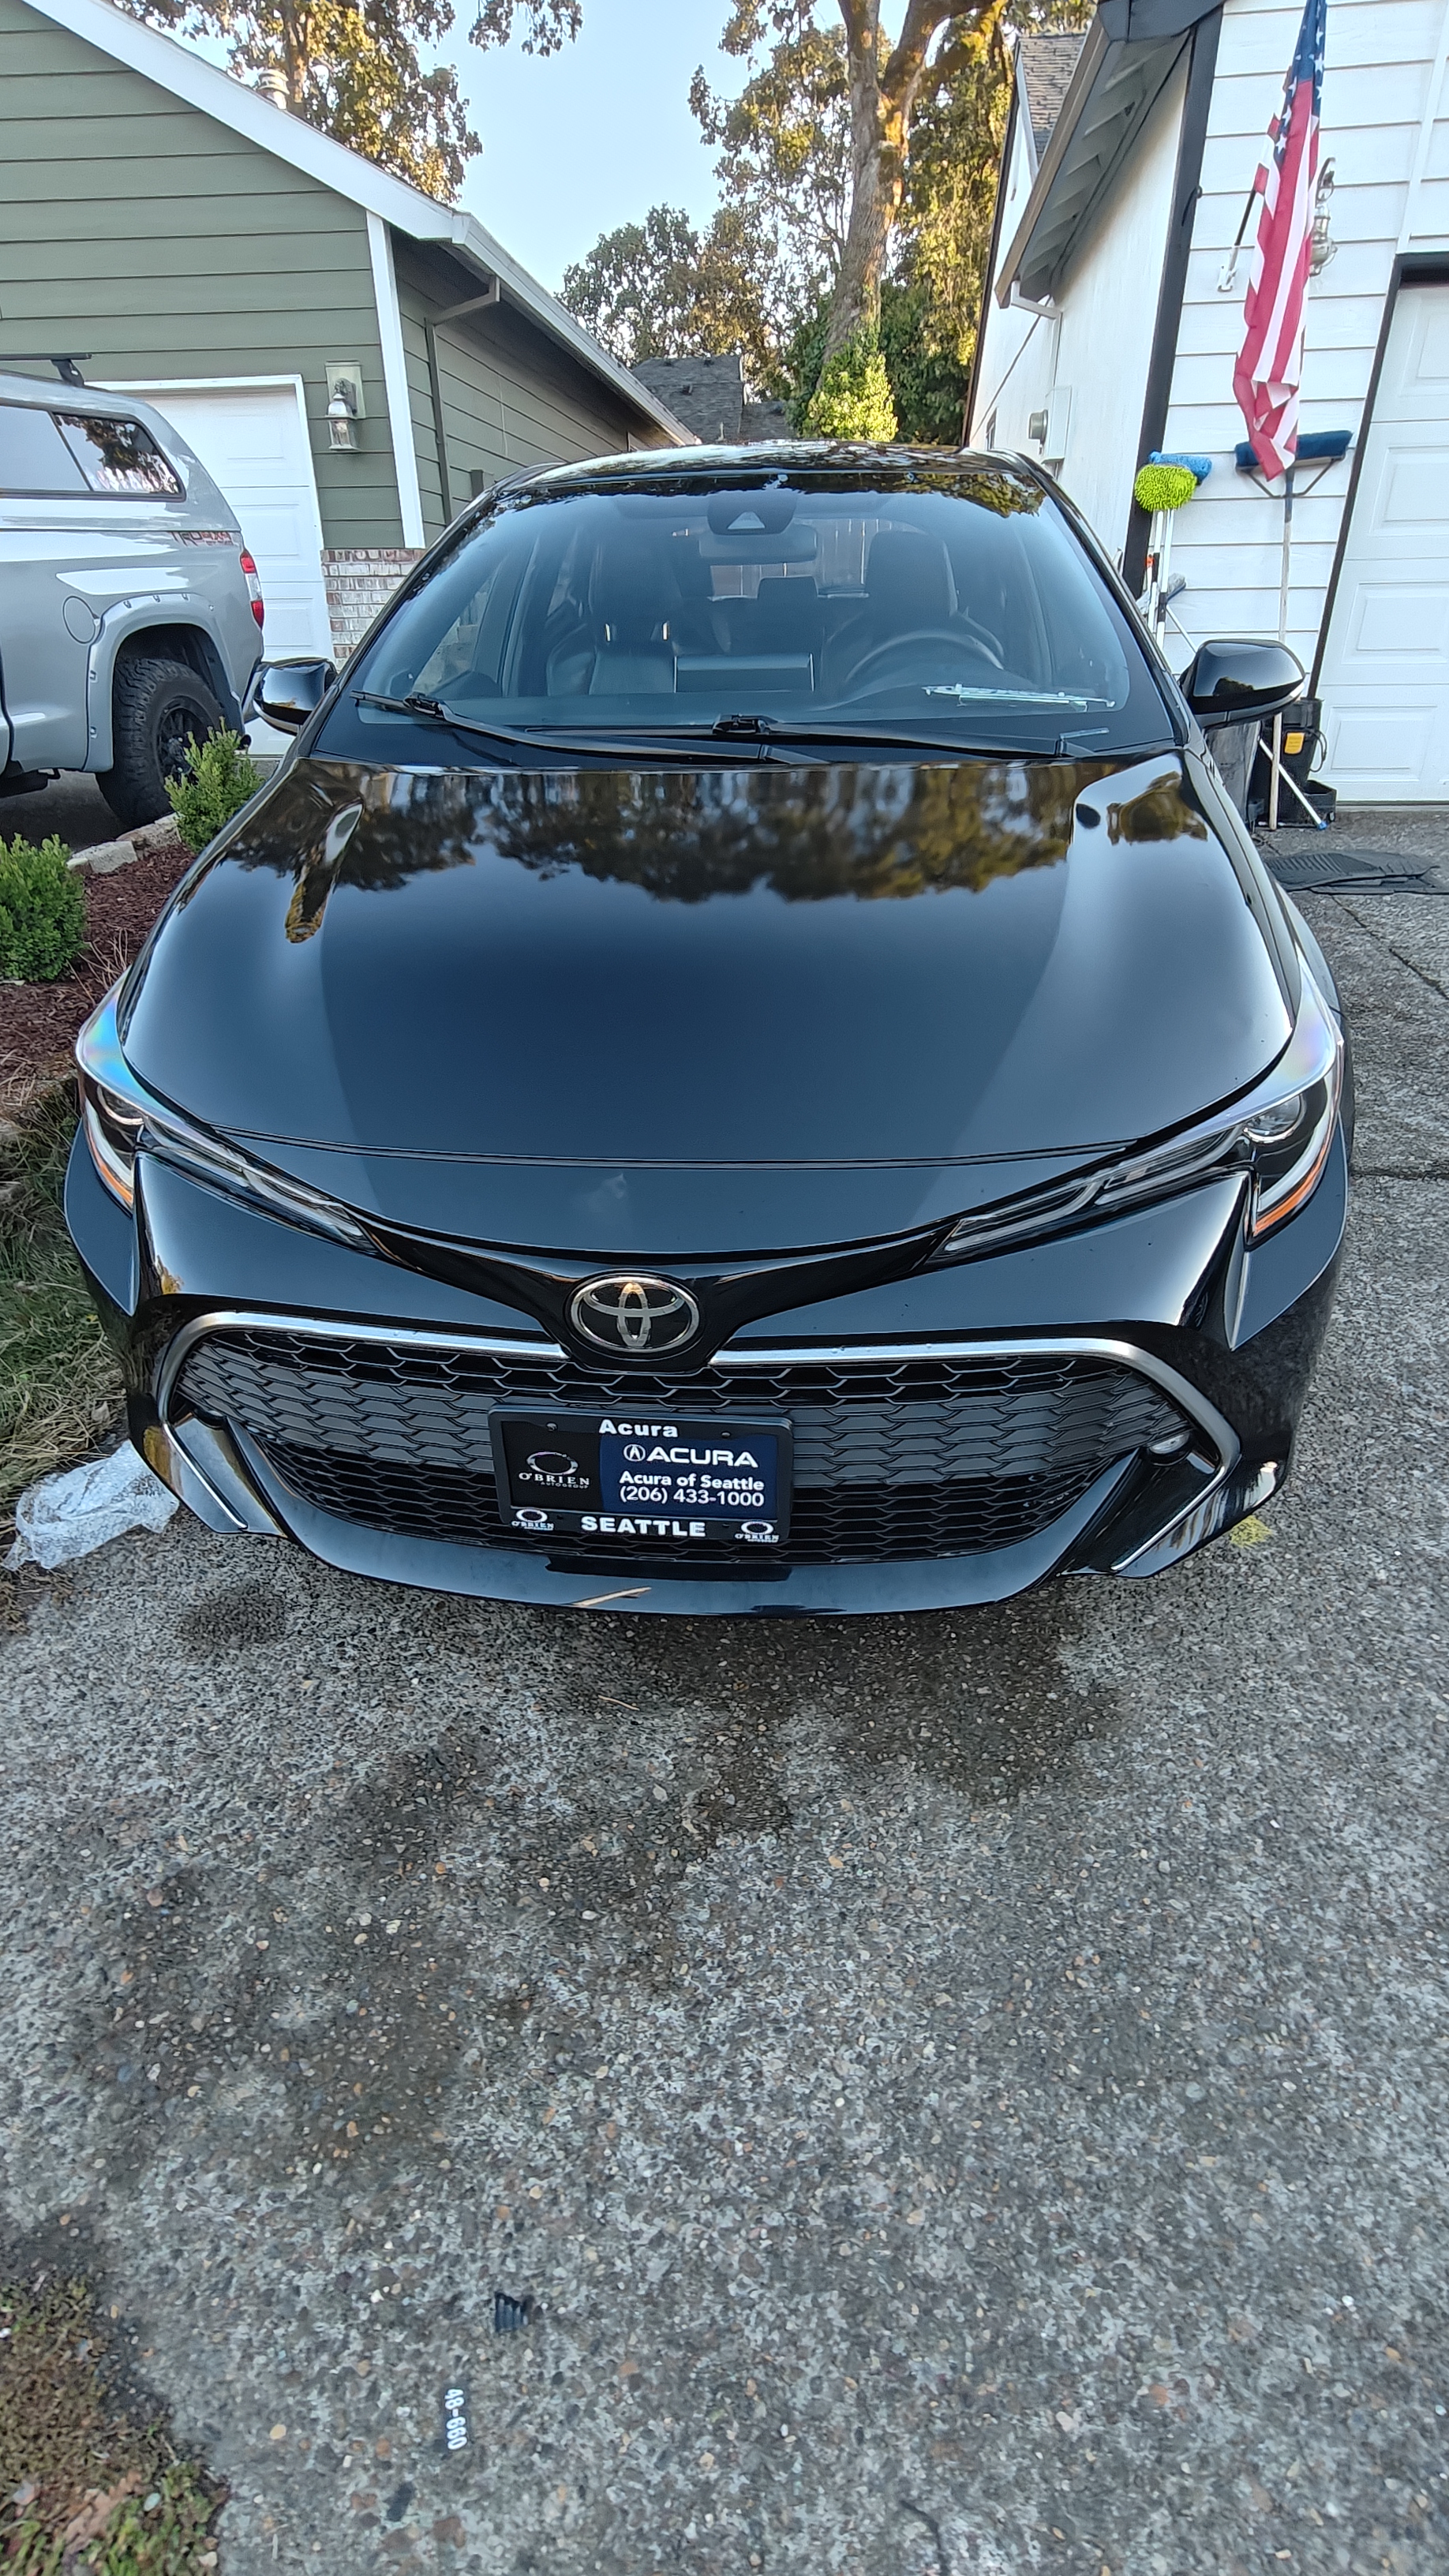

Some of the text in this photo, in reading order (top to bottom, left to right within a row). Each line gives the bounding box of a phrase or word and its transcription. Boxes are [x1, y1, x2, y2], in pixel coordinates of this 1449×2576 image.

[599, 1419, 678, 1437] Acura
[646, 1446, 758, 1468] ACURA
[519, 1472, 590, 1485] O'BRIEN
[620, 1471, 765, 1491] Acura of Seattle
[620, 1486, 765, 1507] (206) 433-1000
[581, 1516, 706, 1537] SEATTLE
[444, 2388, 467, 2450] 48-660
